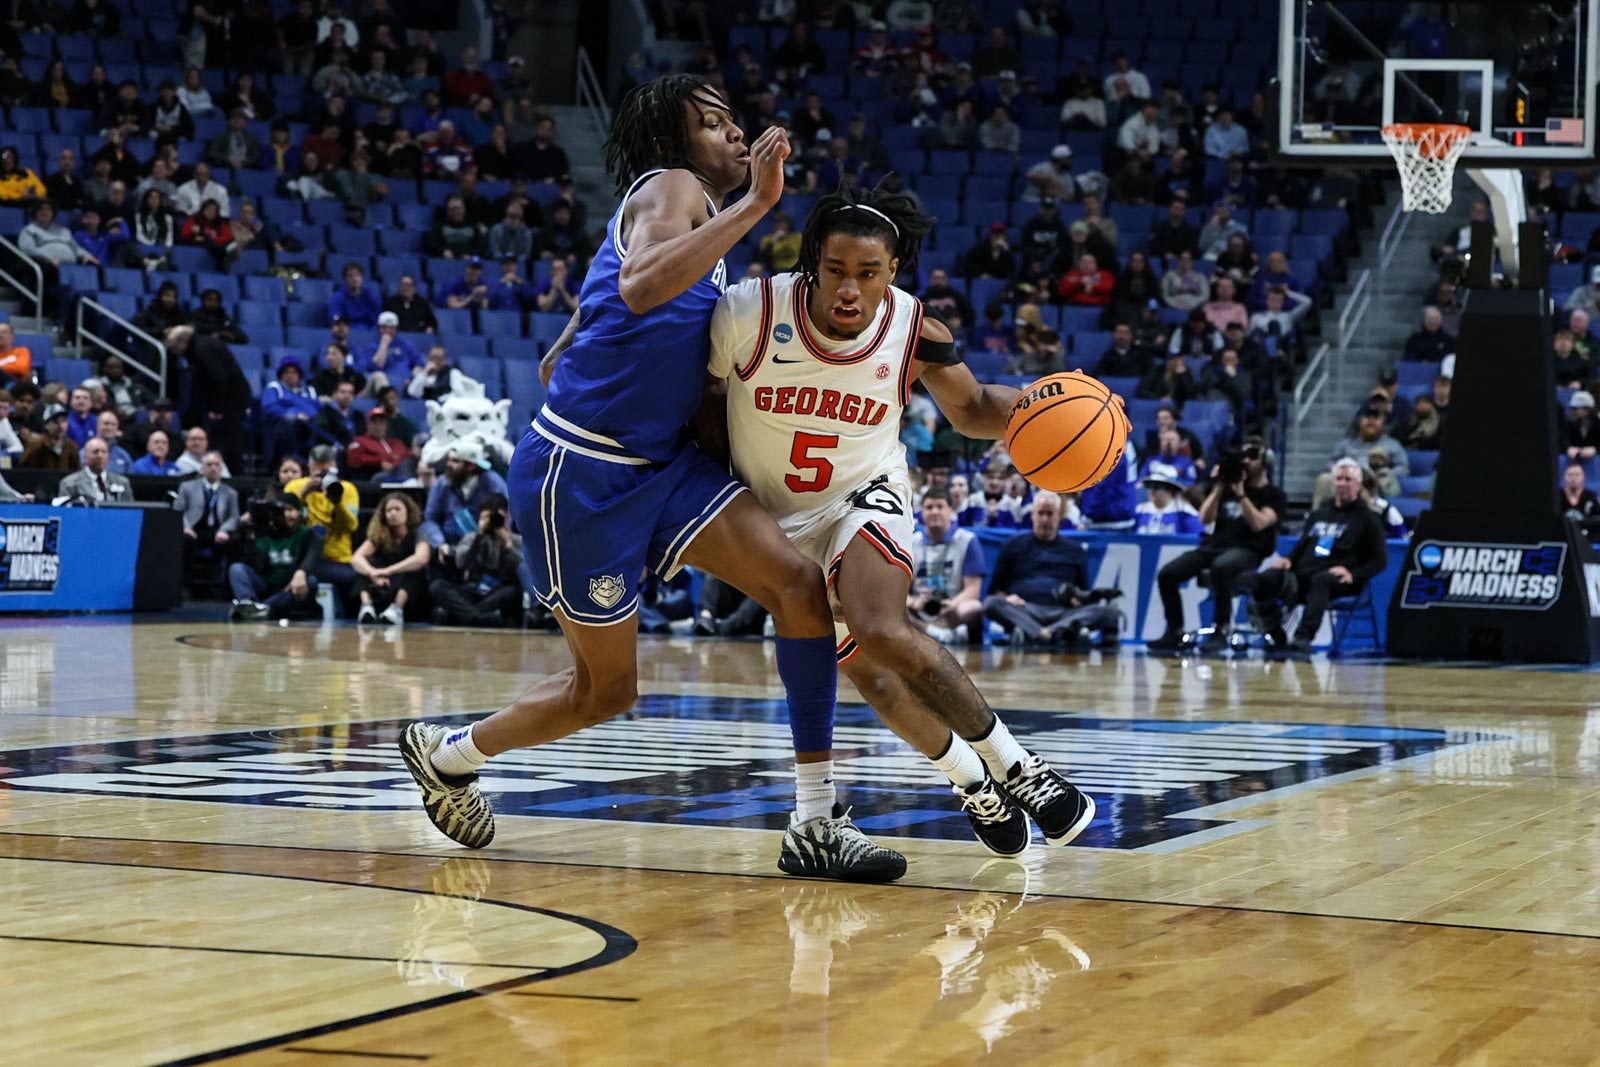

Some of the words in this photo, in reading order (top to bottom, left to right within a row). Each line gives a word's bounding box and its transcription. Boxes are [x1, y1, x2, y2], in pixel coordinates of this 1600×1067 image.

[754, 386, 888, 426] GEORGIA
[784, 431, 839, 493] 5
[1441, 547, 1523, 573] MARCH
[1449, 573, 1558, 599] MADNESS
